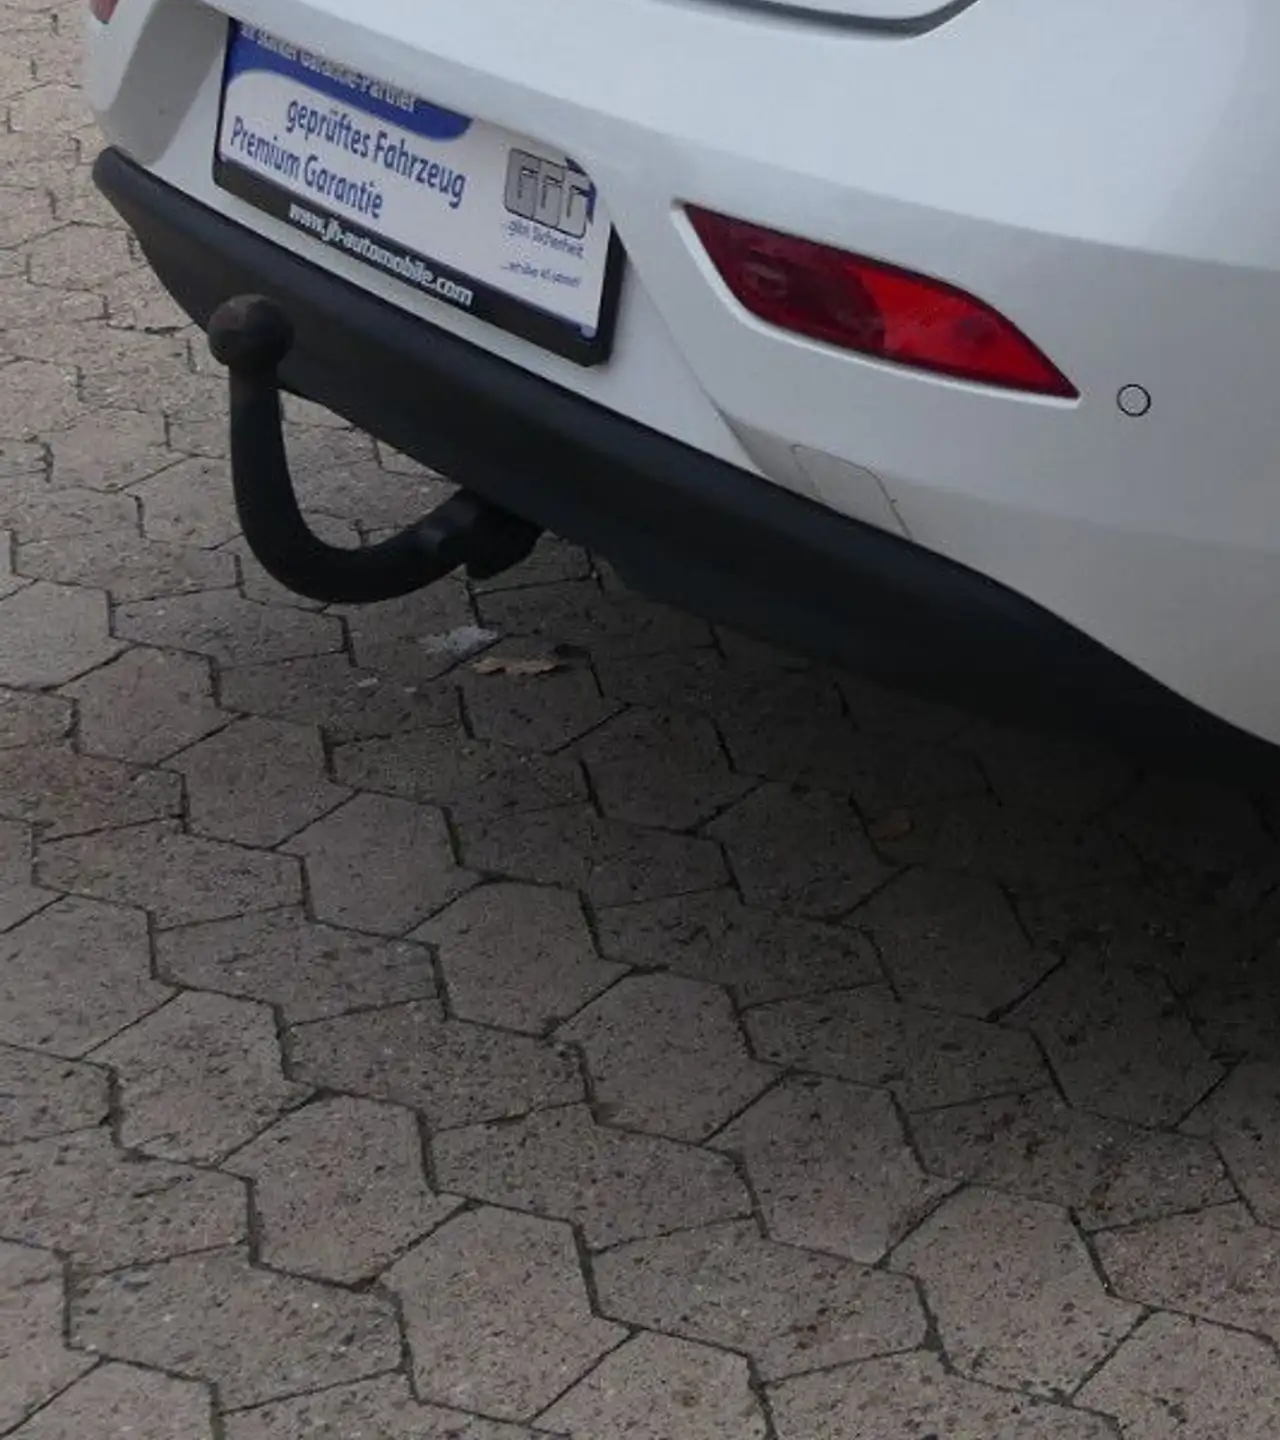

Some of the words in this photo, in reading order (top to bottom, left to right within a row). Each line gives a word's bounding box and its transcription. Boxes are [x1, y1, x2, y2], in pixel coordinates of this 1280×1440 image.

[230, 116, 300, 180] Premium
[304, 154, 383, 219] Garantie
[286, 99, 370, 159] geprüftes
[373, 130, 467, 209] Fahrzeug
